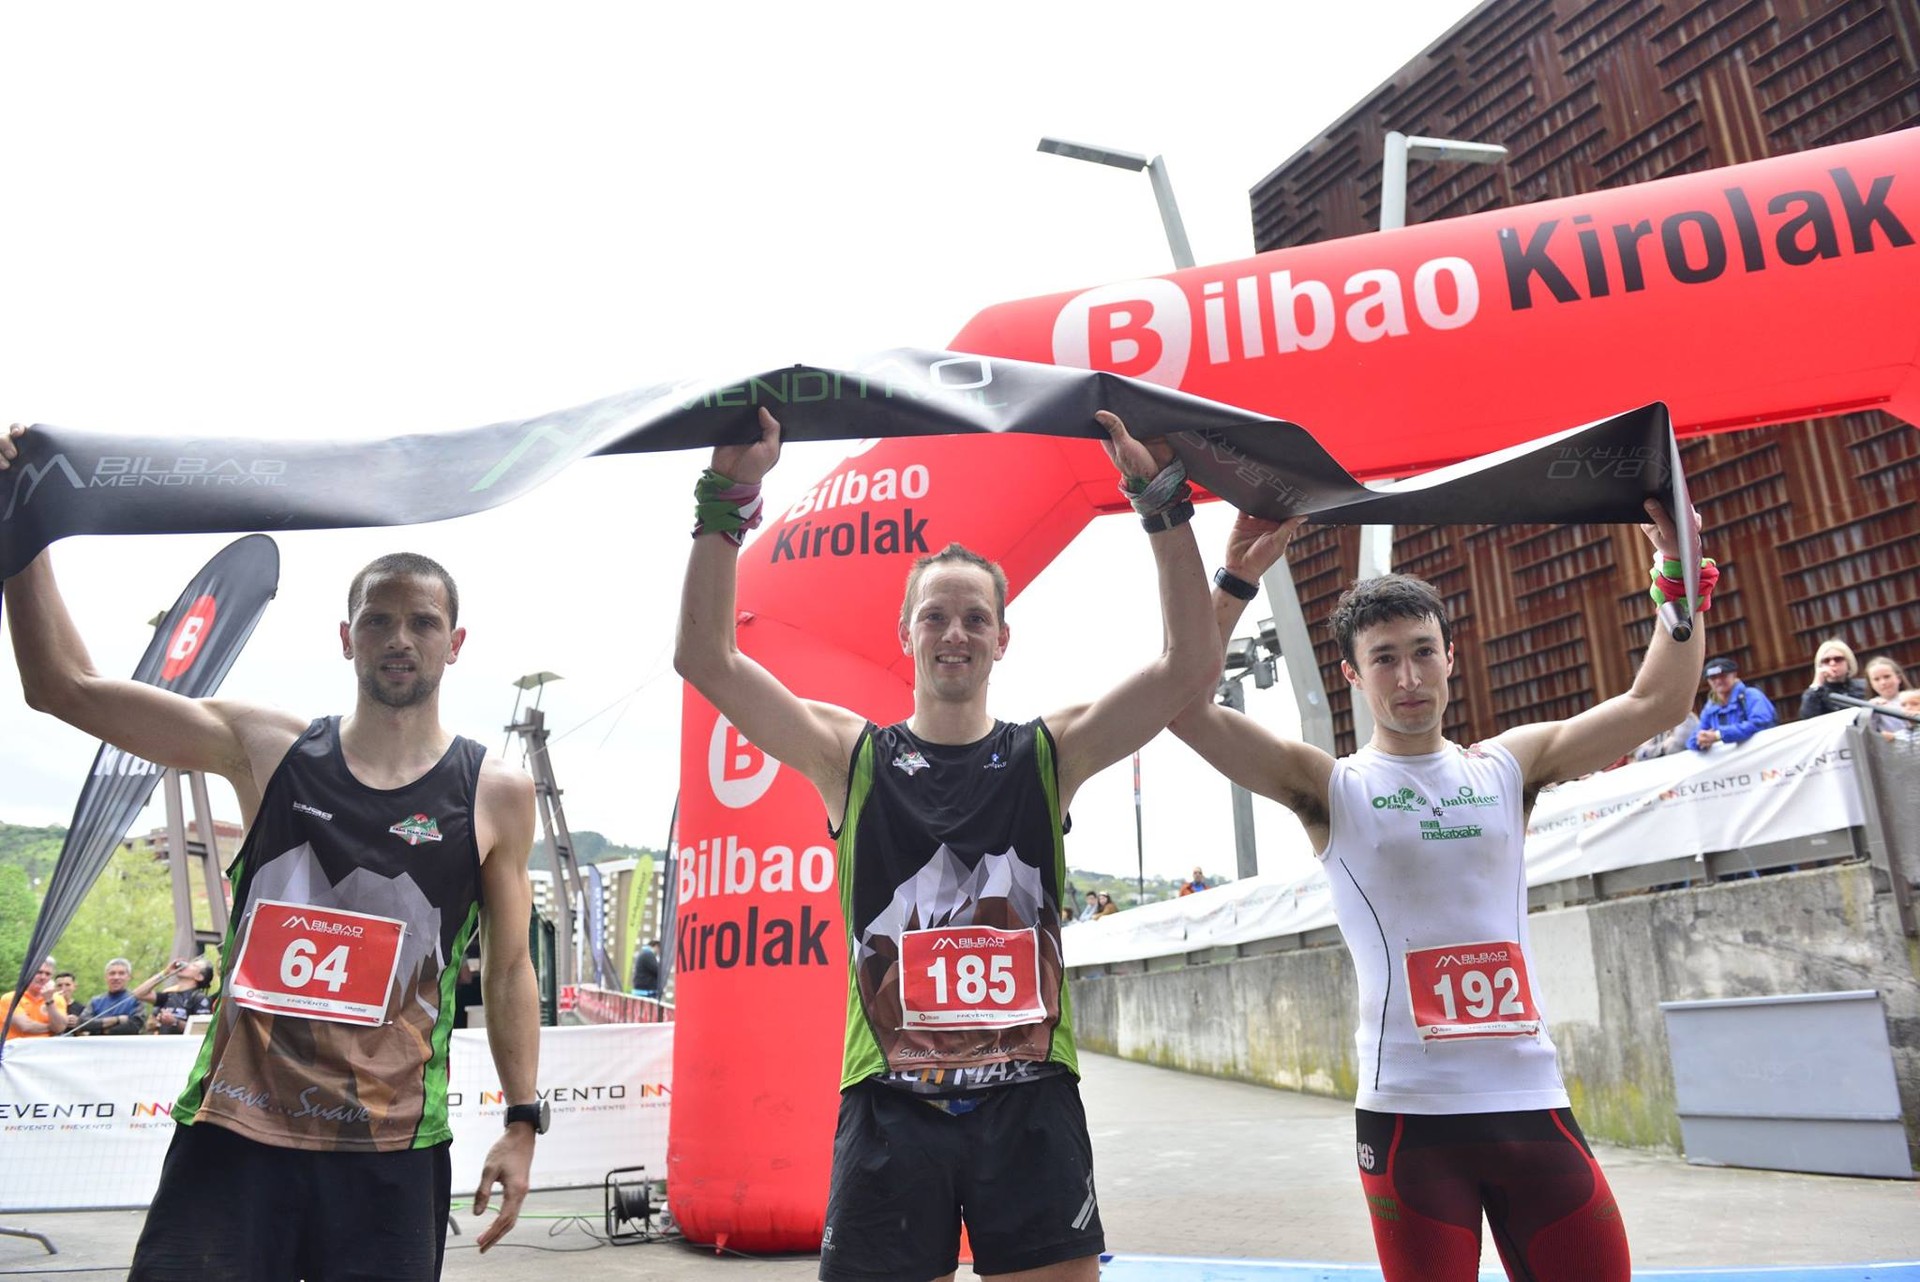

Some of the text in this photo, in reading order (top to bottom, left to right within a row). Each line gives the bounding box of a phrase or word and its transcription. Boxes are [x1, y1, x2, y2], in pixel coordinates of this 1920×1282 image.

[1086, 166, 1915, 378] Bilbao Kirolak
[88, 474, 289, 488] MENDITRAIL
[95, 456, 288, 476] BILBAO
[785, 463, 930, 523] Bilbao
[771, 508, 929, 563] Kirolak
[679, 835, 836, 906] Bilbao
[311, 919, 364, 934] BILBAO
[676, 905, 831, 975] Kirolak
[958, 937, 1005, 945] BILBAO
[279, 938, 351, 993] 64
[927, 954, 1017, 1005] 185
[1433, 966, 1525, 1020] 192
[953, 1060, 1031, 1086] MAX
